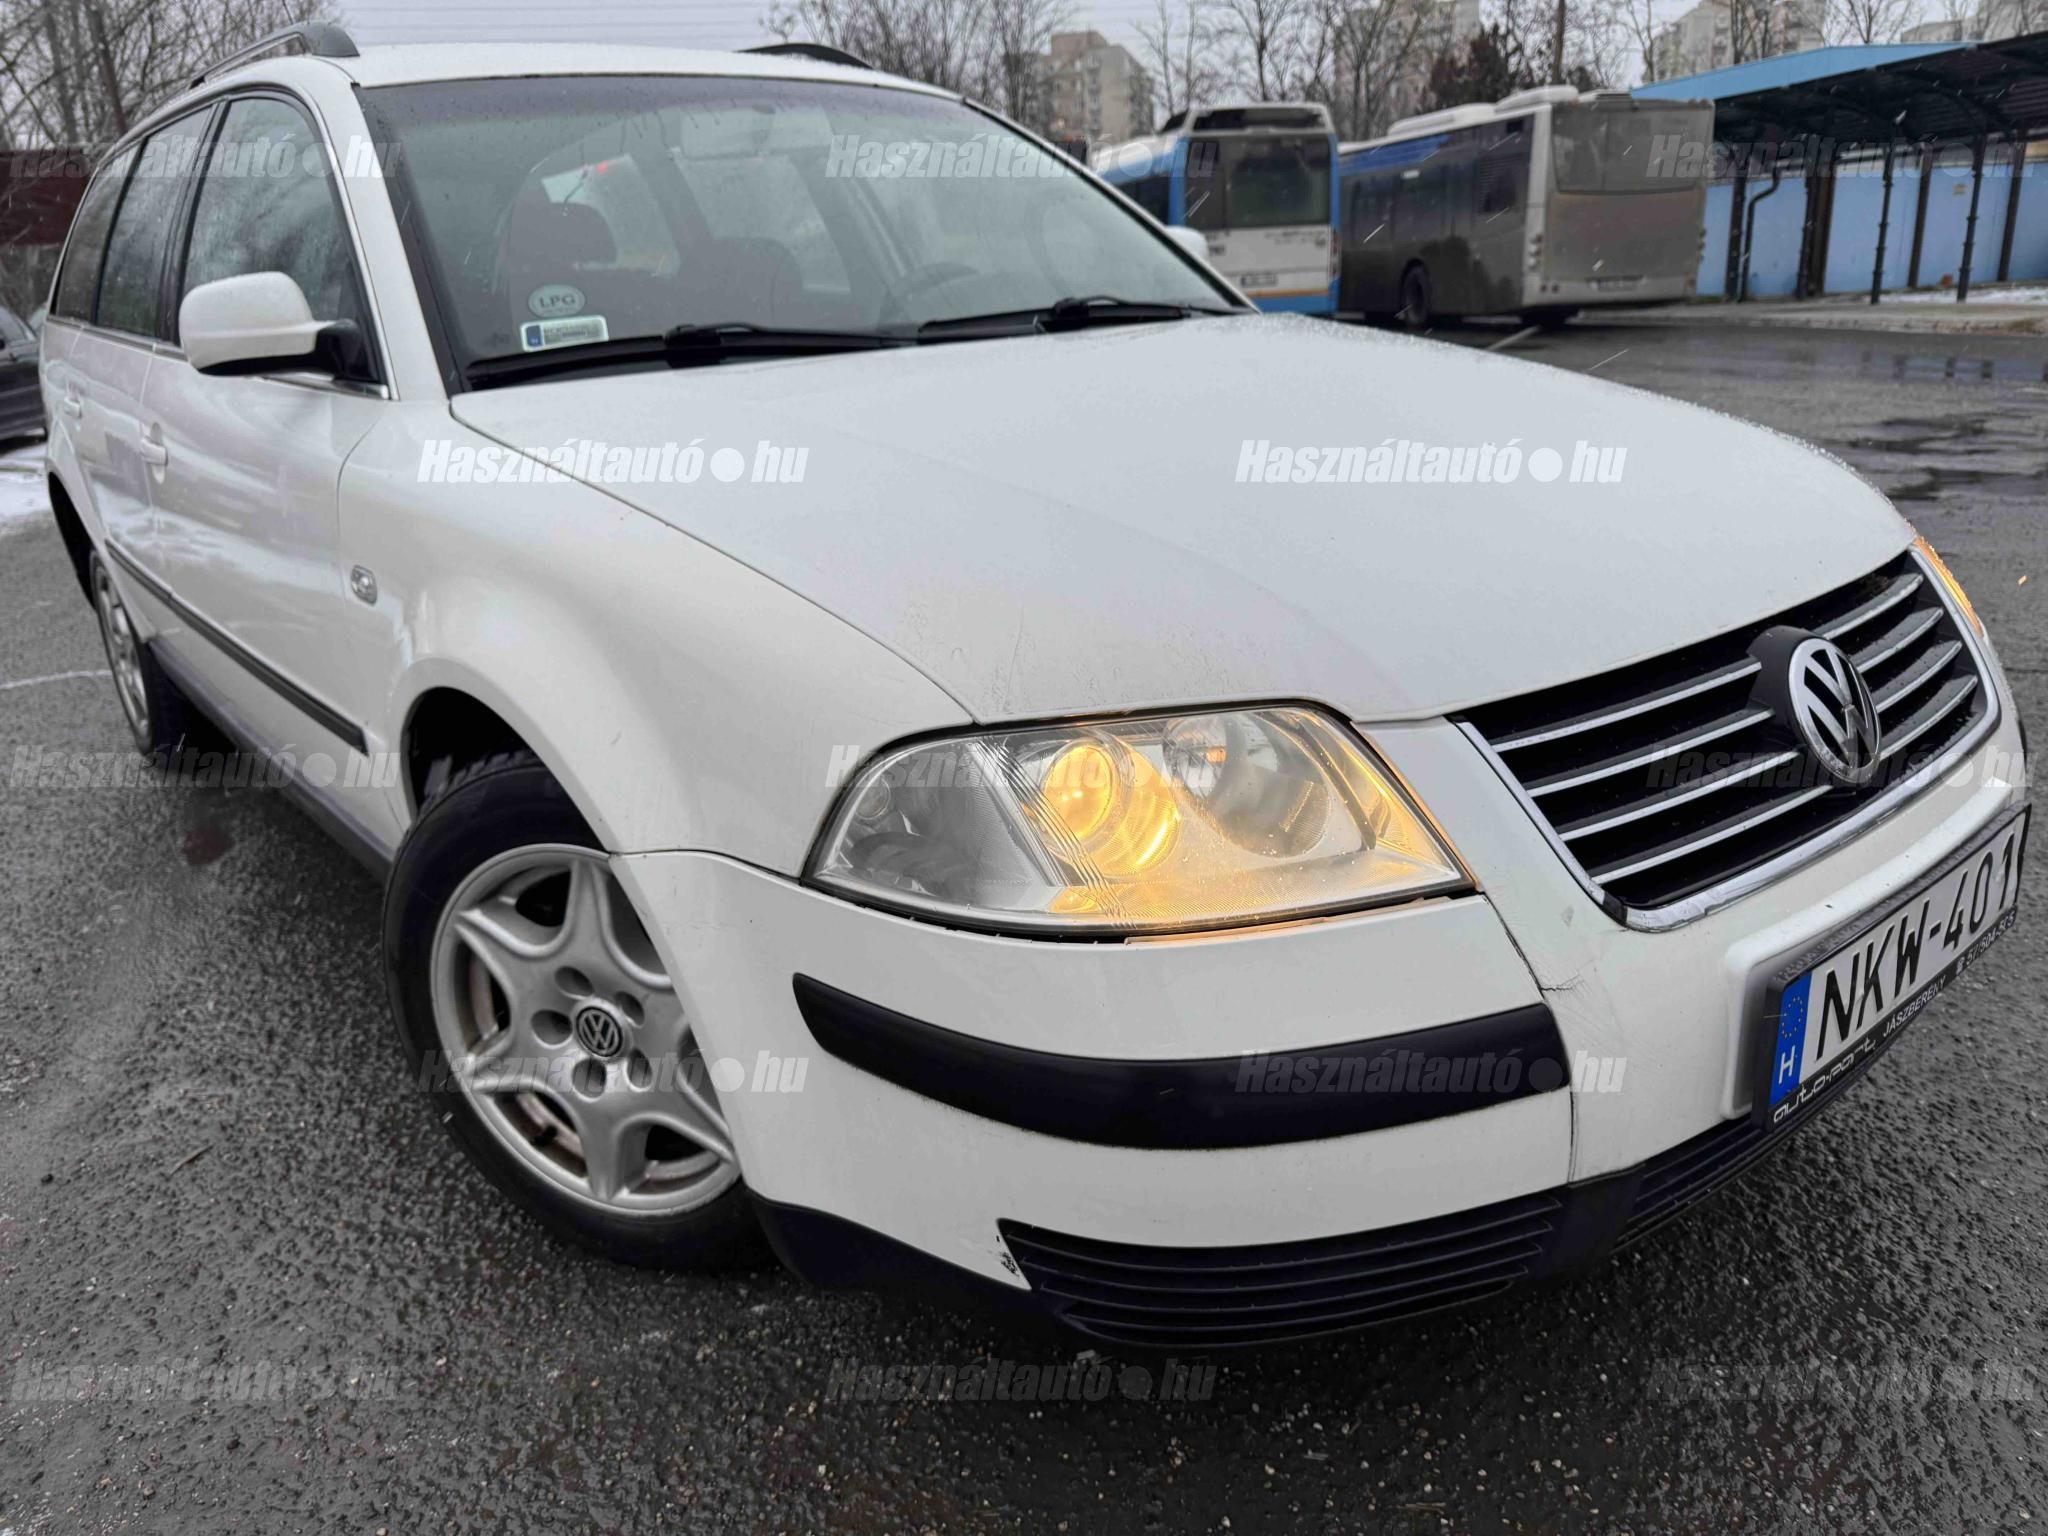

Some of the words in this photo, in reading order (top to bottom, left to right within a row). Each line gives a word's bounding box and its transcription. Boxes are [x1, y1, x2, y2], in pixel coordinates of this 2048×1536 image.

[539, 294, 576, 308] LPG
[1777, 1045, 1796, 1085] H
[1816, 832, 2016, 1062] NKW-401
